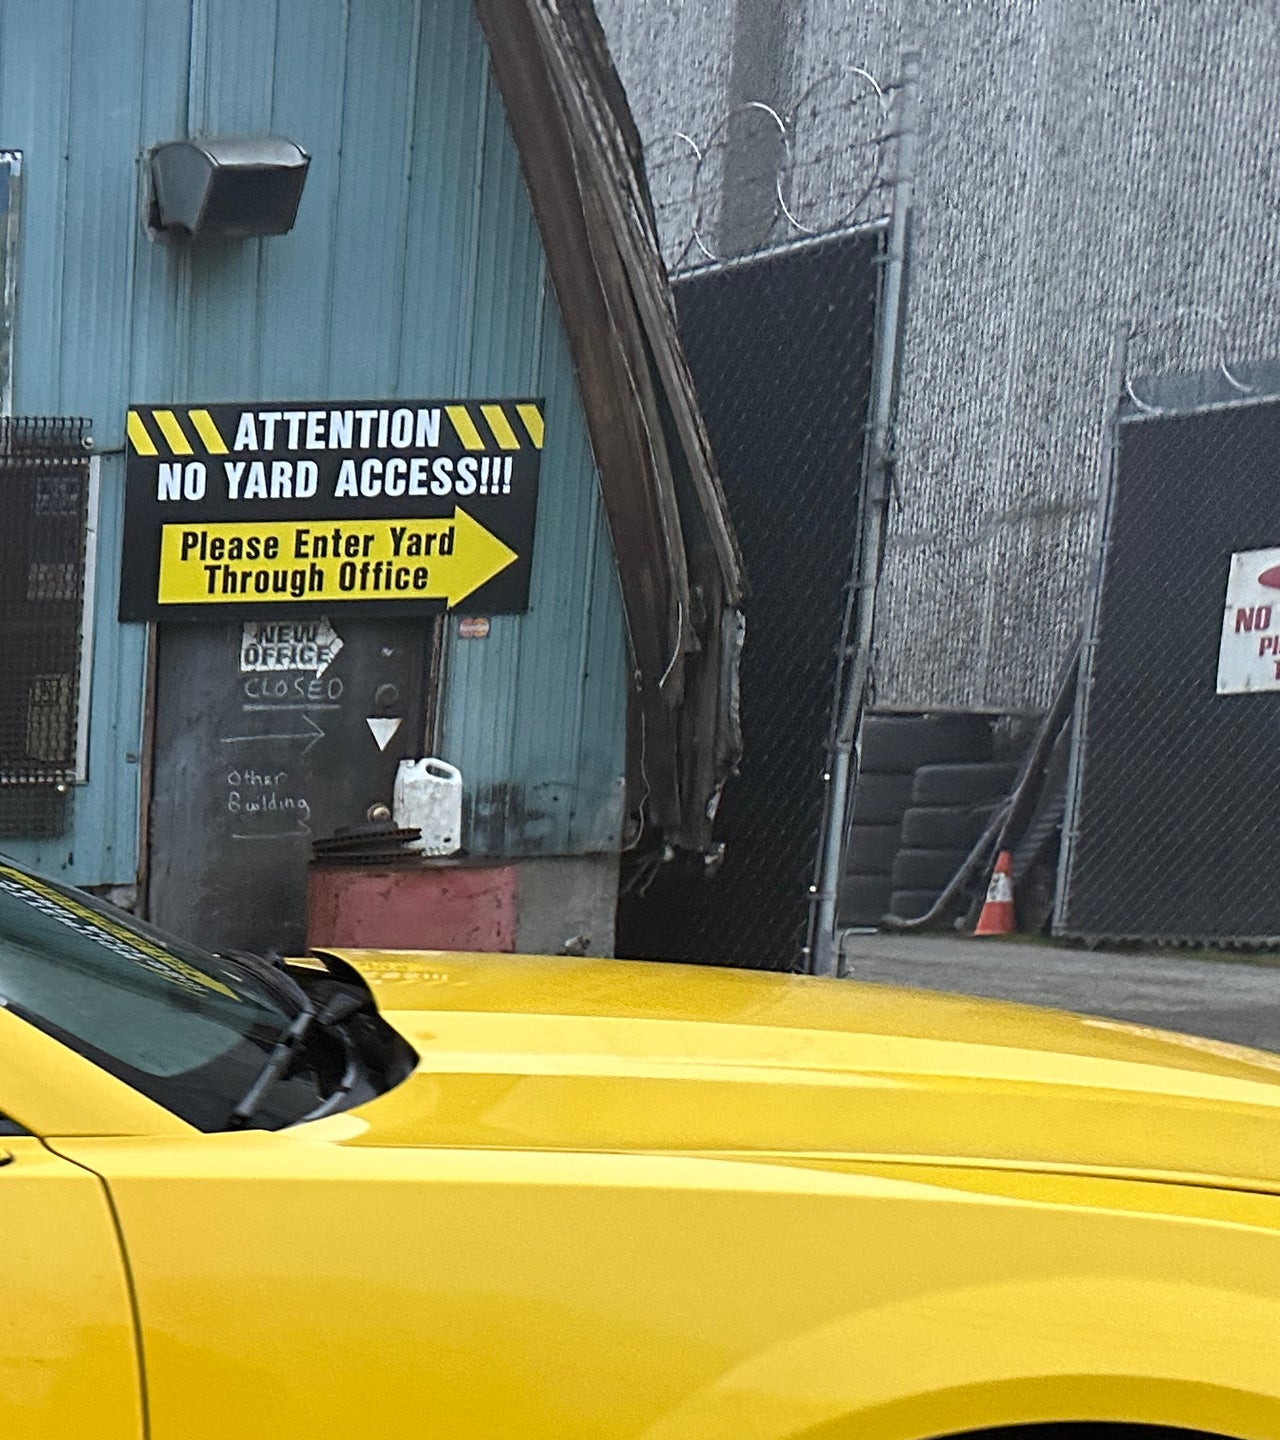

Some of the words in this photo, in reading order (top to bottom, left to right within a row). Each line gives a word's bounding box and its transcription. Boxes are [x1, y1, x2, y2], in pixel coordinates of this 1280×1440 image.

[233, 408, 441, 452] ATTENTION
[157, 461, 207, 501] NO
[224, 459, 319, 500] YARD
[334, 456, 514, 498] ACCESS!!!
[180, 530, 279, 561] Please
[294, 528, 375, 559] Enter
[390, 526, 455, 557] Yard
[204, 563, 324, 598] Through
[339, 560, 428, 592] Office
[1234, 605, 1272, 633] NO
[259, 624, 318, 644] NEW
[243, 643, 331, 667] OFFICE
[244, 676, 344, 700] CLOSED
[227, 769, 289, 787] Other
[227, 790, 311, 821] Building
